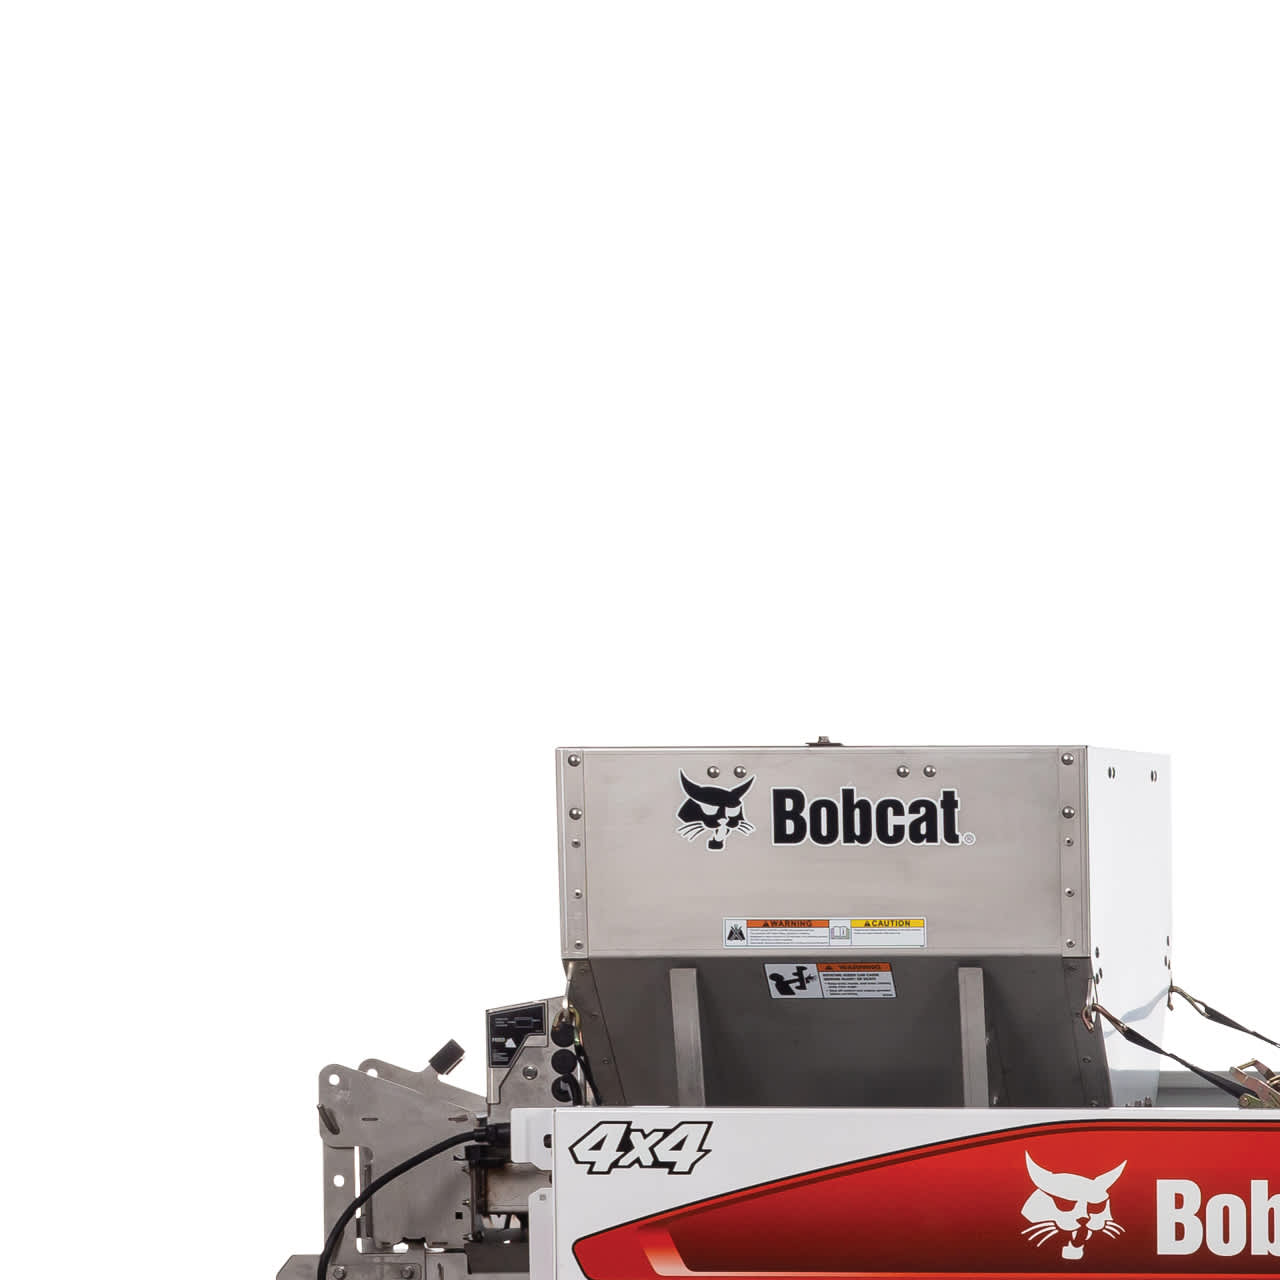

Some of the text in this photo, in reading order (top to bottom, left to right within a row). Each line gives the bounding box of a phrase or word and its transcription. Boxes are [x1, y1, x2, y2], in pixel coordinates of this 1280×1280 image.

[771, 919, 813, 928] WARNING
[872, 919, 911, 928] CAUTION
[568, 1121, 713, 1175] 4x4
